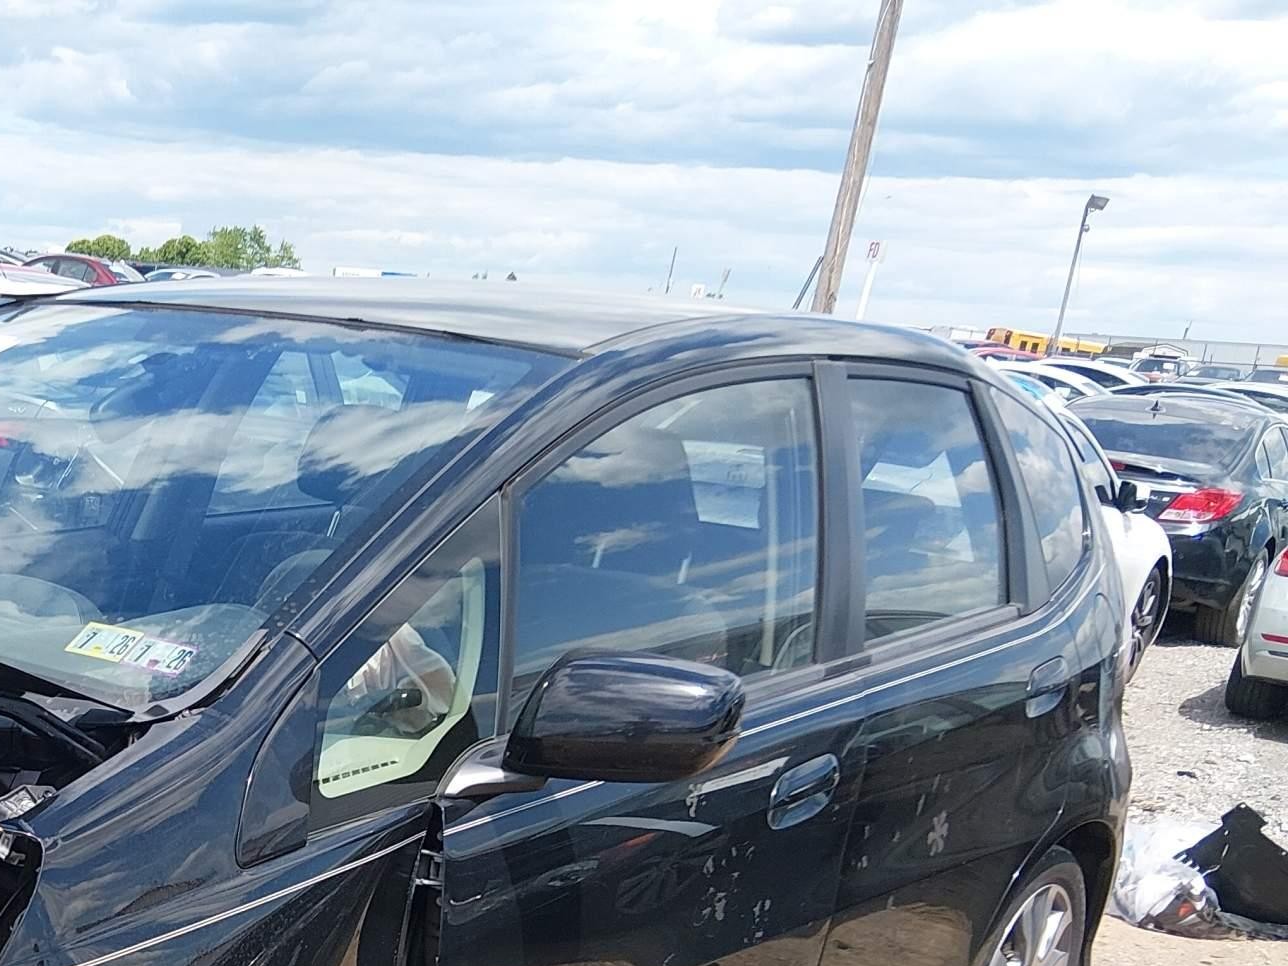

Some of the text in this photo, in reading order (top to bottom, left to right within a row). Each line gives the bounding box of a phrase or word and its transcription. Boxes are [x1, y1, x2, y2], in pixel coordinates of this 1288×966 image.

[78, 631, 137, 656] 7 26
[133, 644, 196, 671] 7 26
